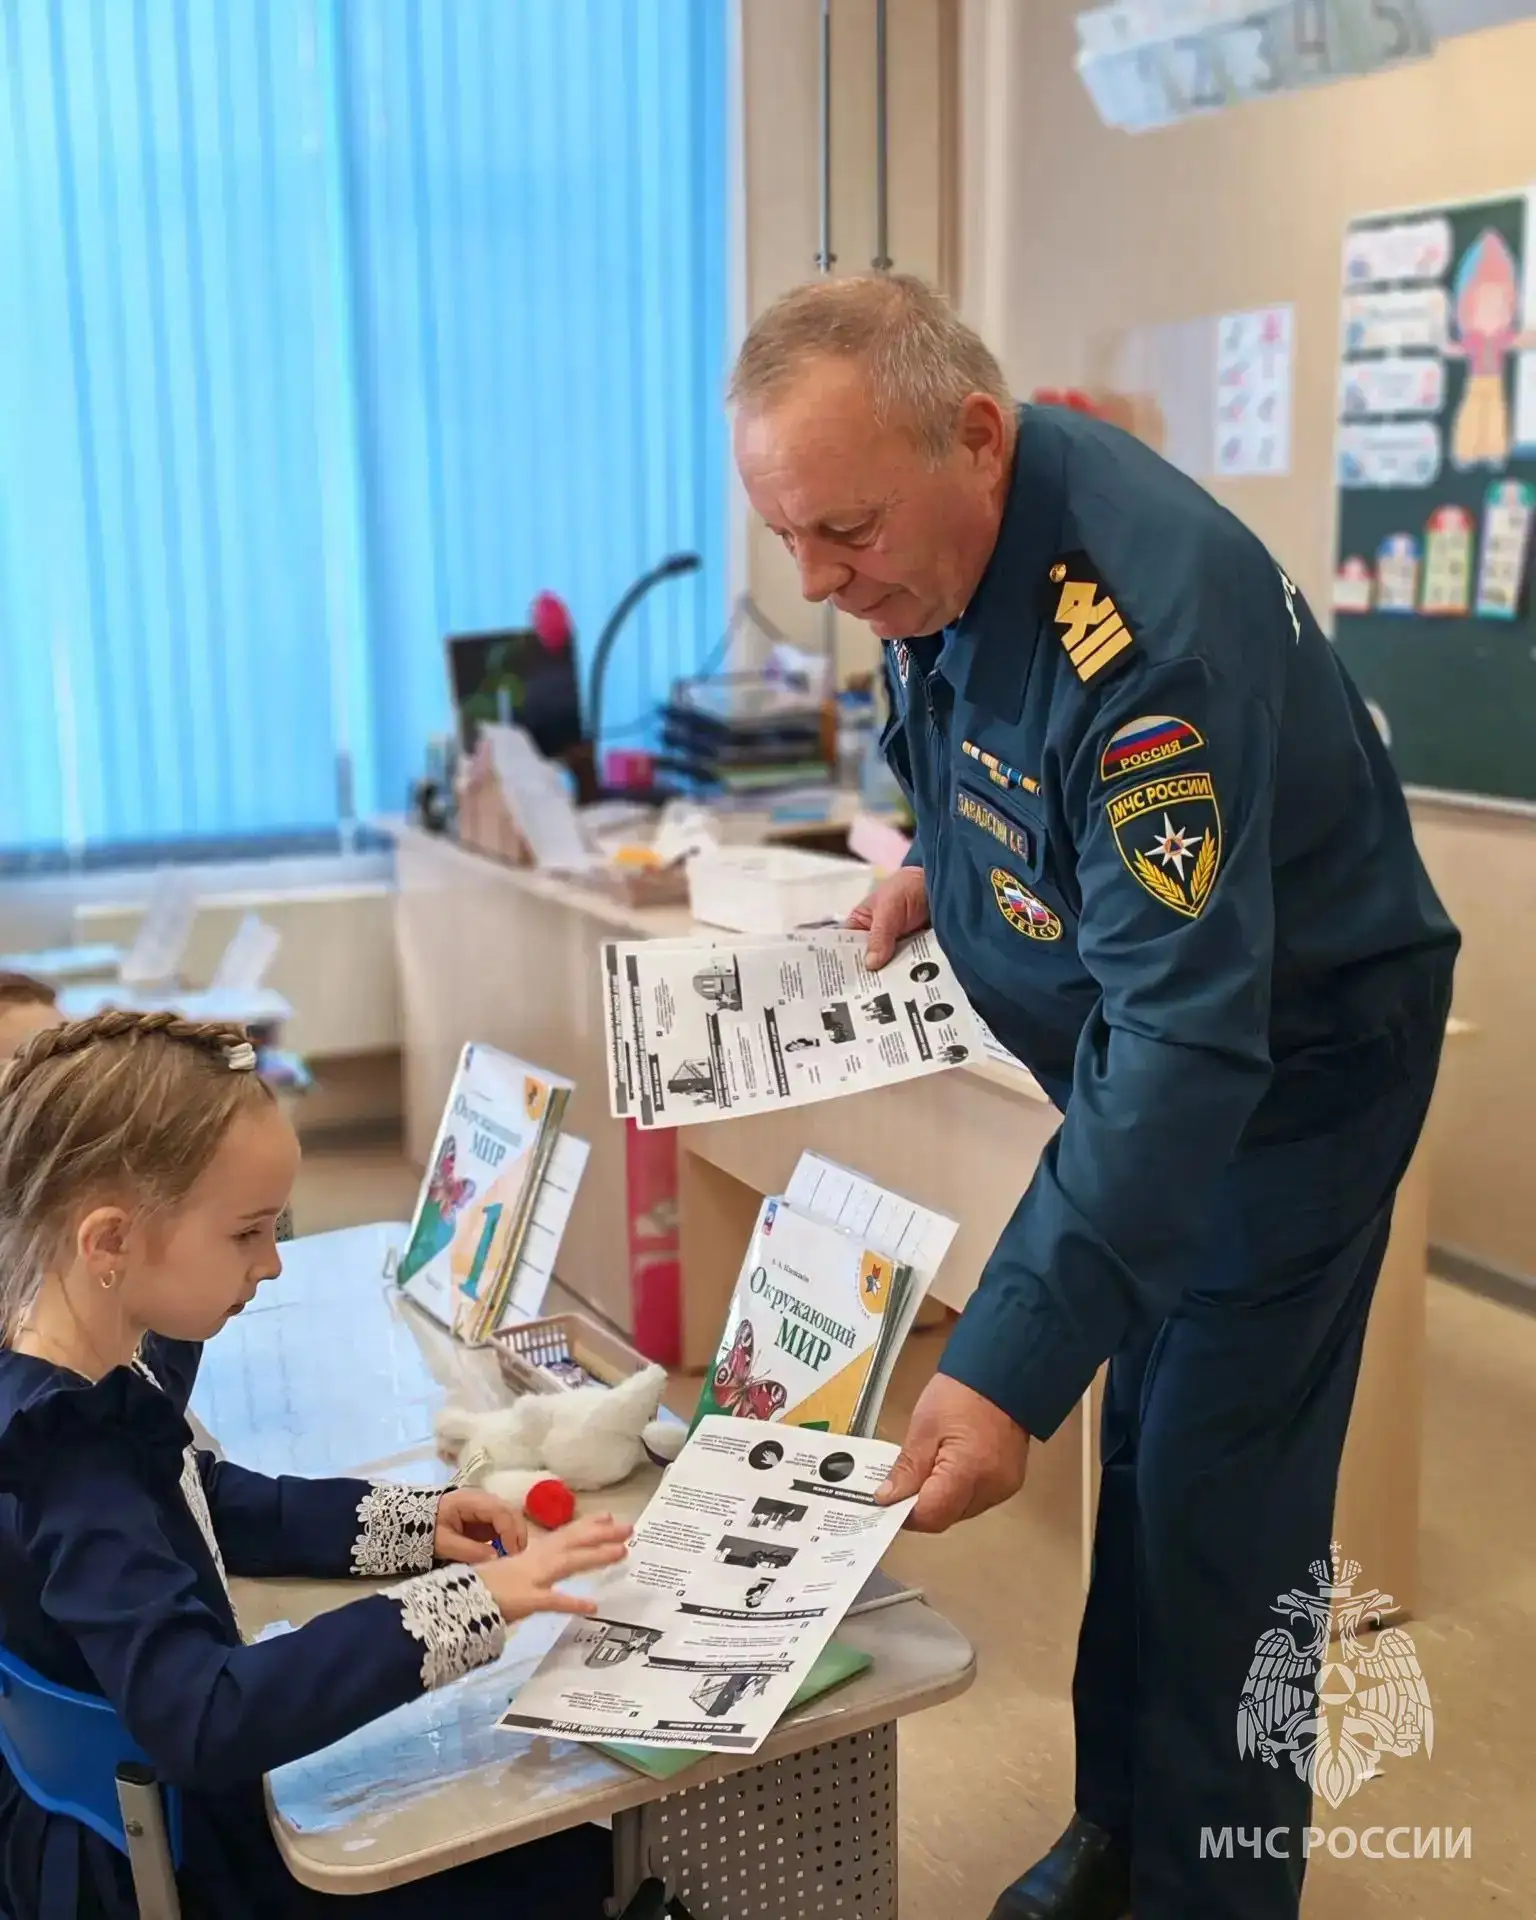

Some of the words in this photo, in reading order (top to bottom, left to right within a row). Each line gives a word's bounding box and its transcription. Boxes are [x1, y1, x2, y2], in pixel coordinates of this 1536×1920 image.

[1120, 739, 1181, 769] РОССИЯ
[1112, 791, 1146, 822] МЧС
[1145, 778, 1210, 805] РОССИИ
[459, 1202, 503, 1300] 1
[750, 1266, 857, 1349] Окружающий
[774, 1316, 832, 1372] МИР
